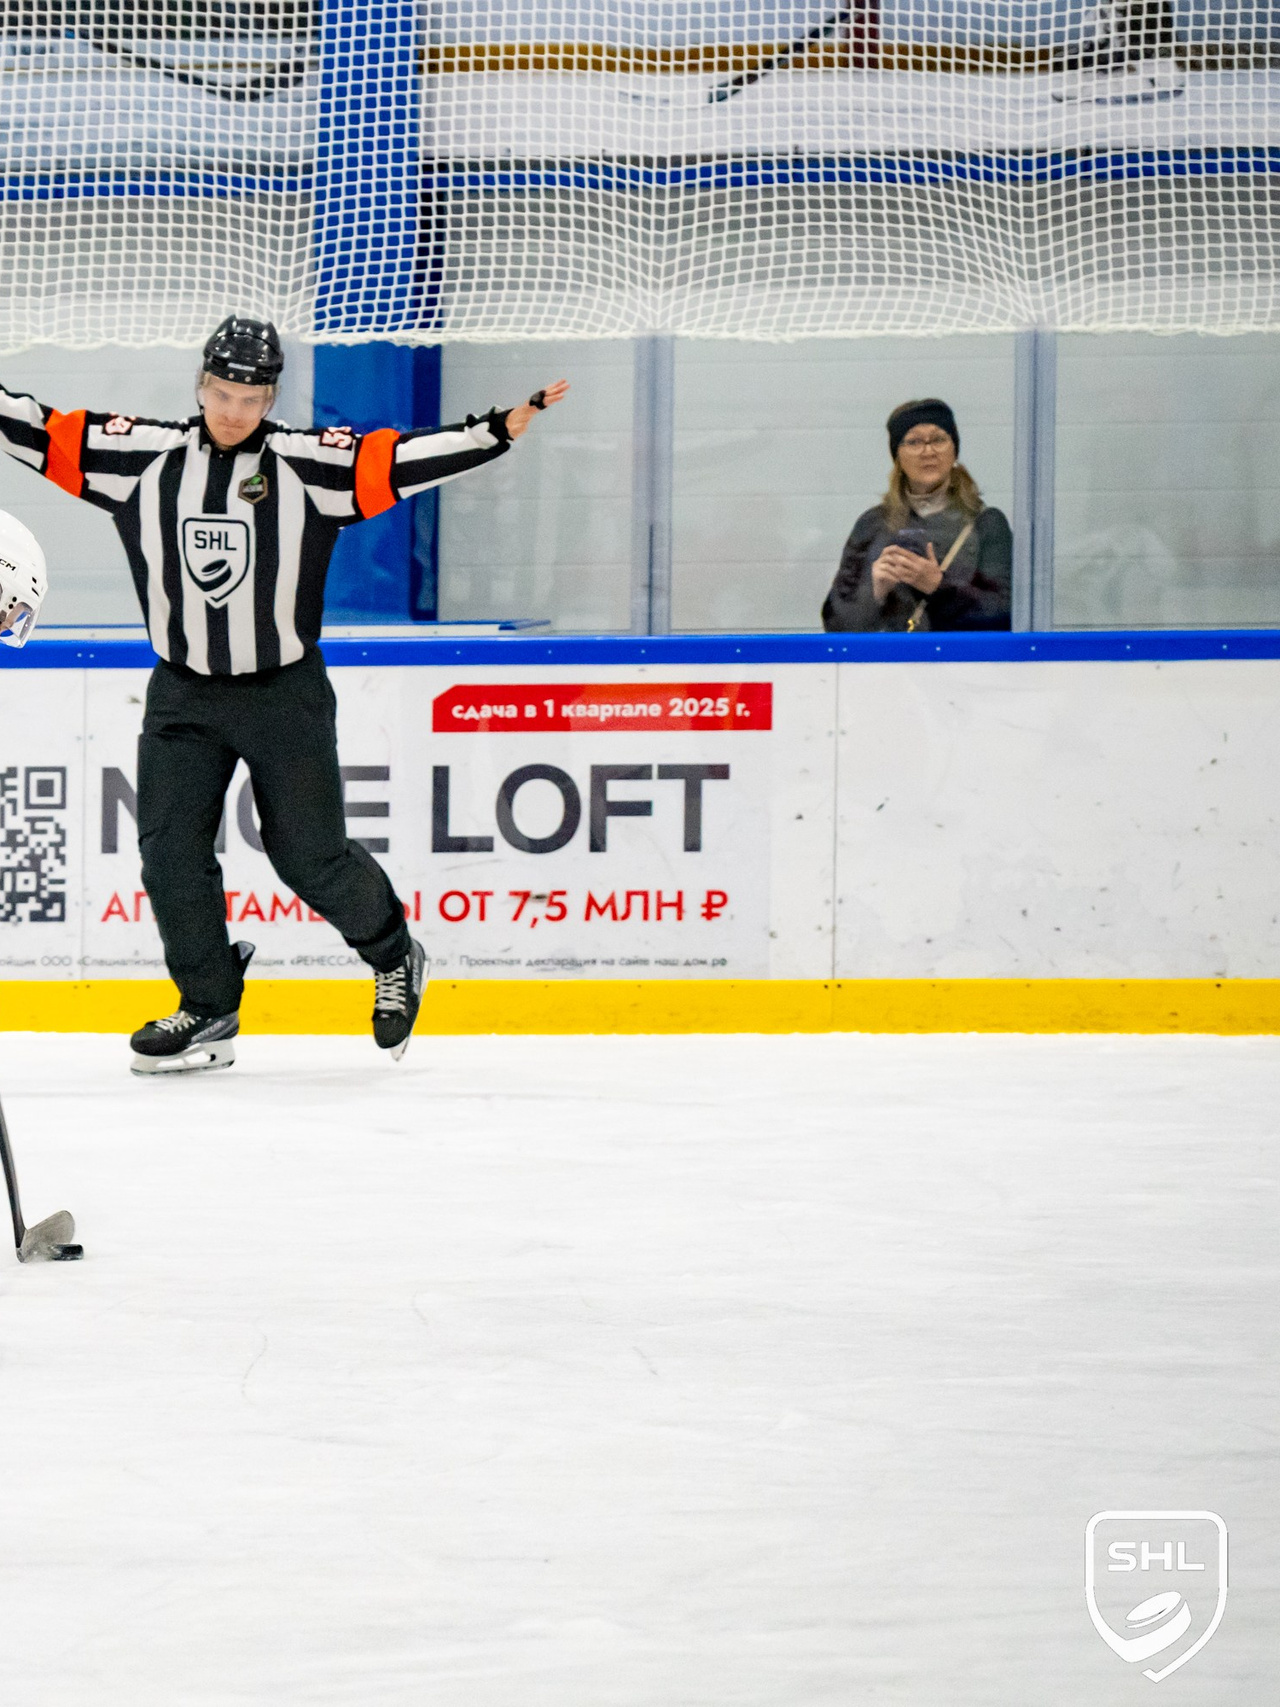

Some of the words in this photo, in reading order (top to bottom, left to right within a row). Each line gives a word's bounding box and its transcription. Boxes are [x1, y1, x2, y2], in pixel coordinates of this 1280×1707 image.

[194, 530, 237, 551] SHL
[451, 702, 518, 721] сдача
[524, 703, 538, 718] в
[543, 699, 555, 718] 1
[561, 702, 663, 722] квартале
[669, 697, 730, 717] 2025
[735, 701, 751, 717] г.
[432, 763, 730, 854] LOFT
[438, 890, 494, 922] ОТ
[508, 890, 567, 928] 7,5
[584, 890, 684, 921] МЛН
[40, 955, 72, 967] ООО
